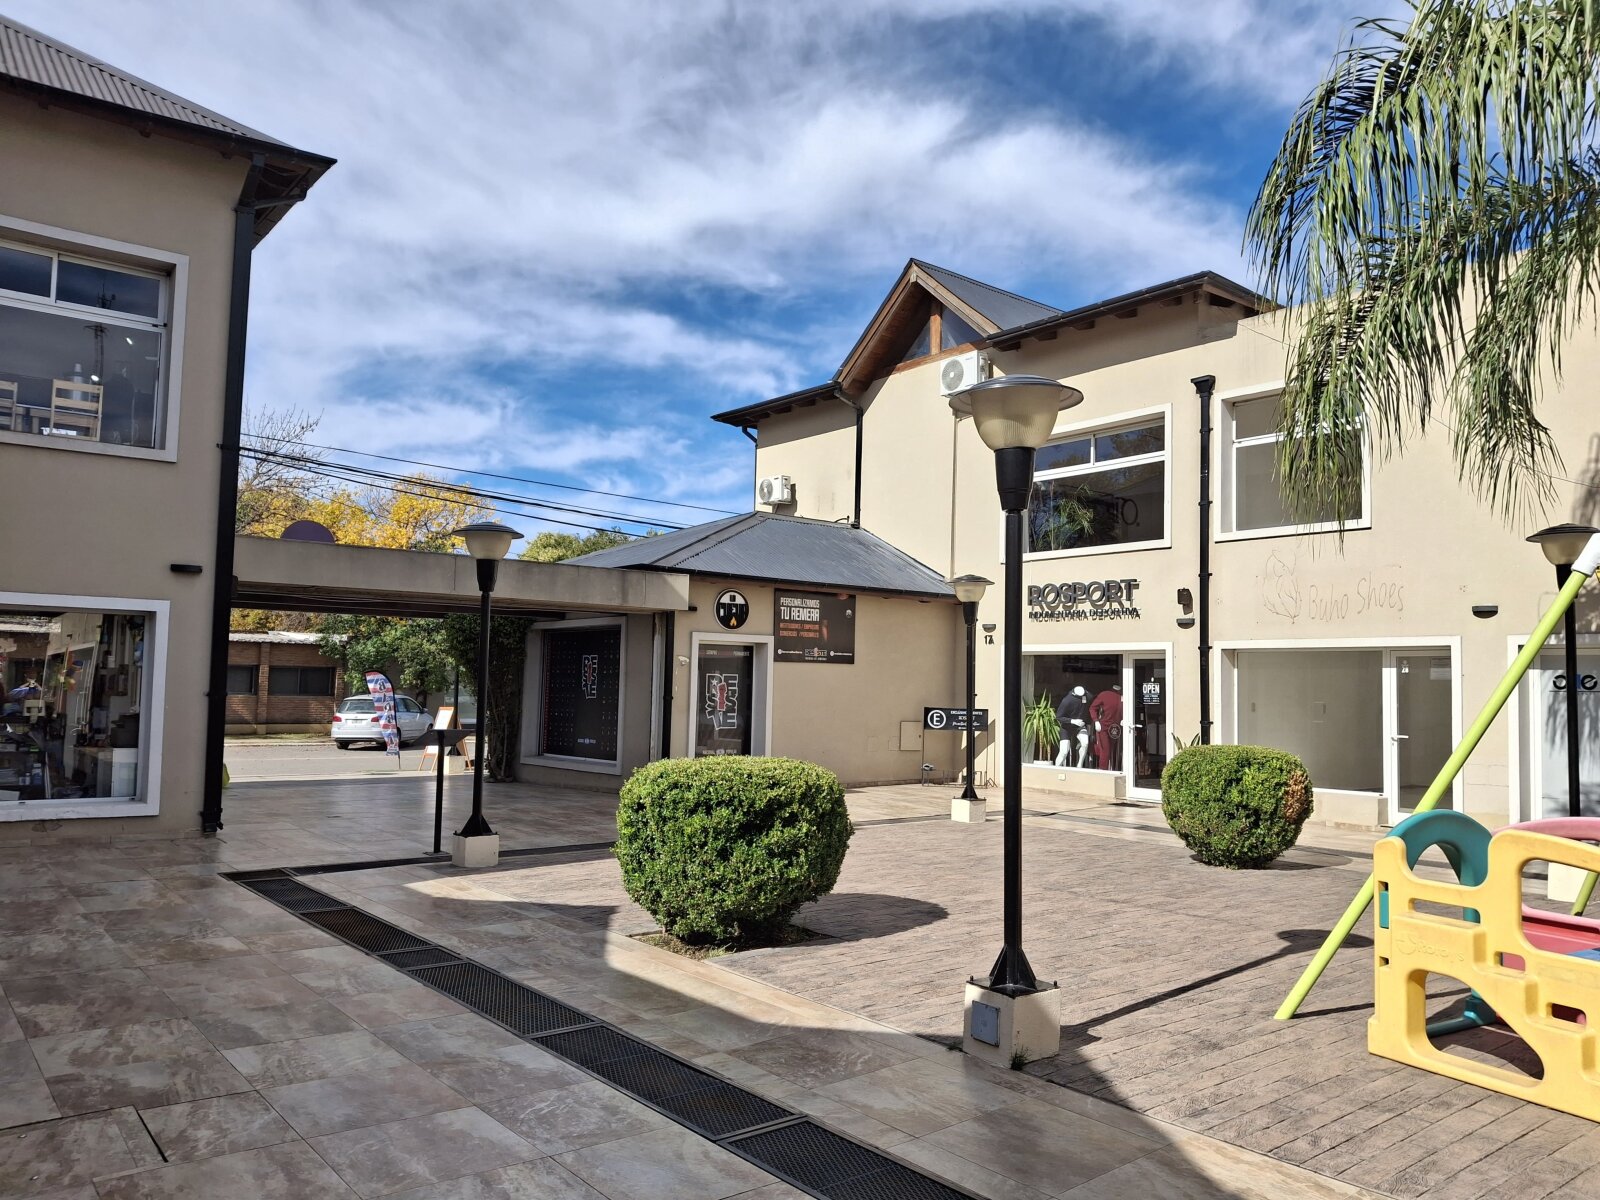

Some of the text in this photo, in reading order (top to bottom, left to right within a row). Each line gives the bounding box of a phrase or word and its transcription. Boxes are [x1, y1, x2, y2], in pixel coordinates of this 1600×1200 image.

[1027, 578, 1139, 607] ROSPORT
[1357, 571, 1404, 614] Shoes
[780, 597, 820, 608] PERSONALIZAMOS
[780, 606, 820, 621] TU REMERA
[1142, 684, 1160, 694] OPEN
[933, 713, 941, 725] E
